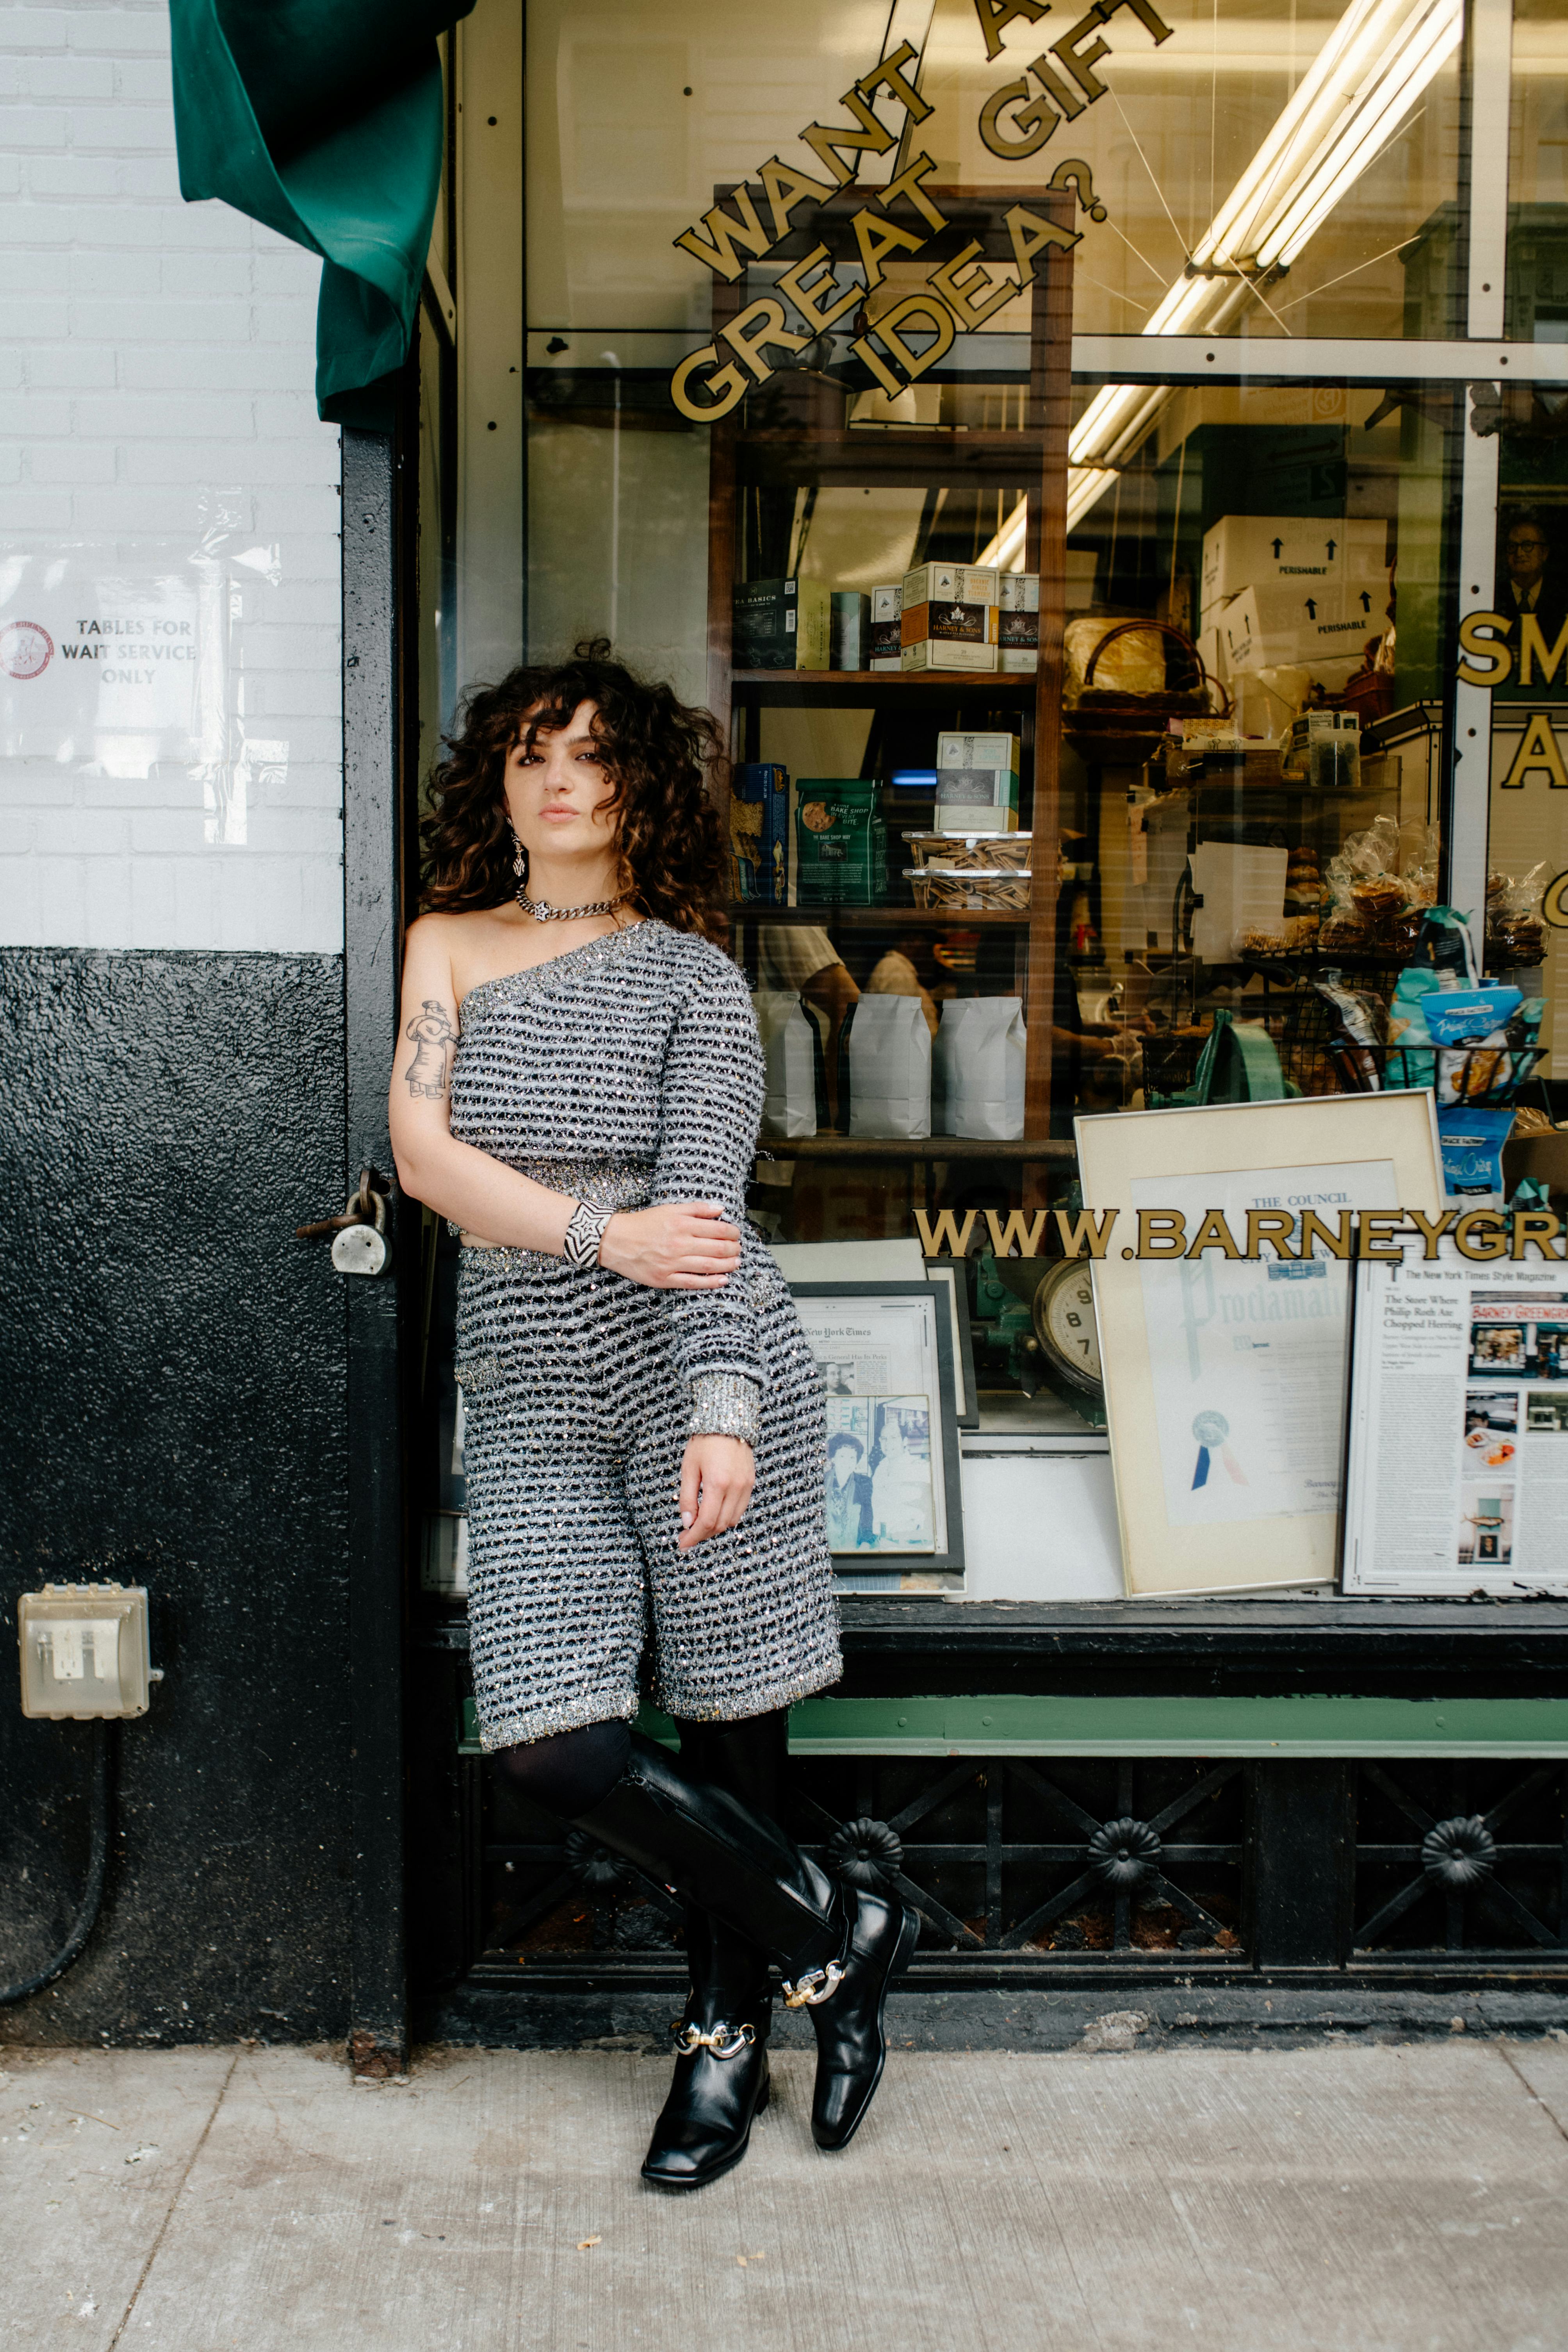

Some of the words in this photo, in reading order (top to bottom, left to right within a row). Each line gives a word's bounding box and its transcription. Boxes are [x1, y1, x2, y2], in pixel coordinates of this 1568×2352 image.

[673, 39, 936, 285] WANT
[974, 0, 1051, 62] A
[668, 150, 953, 426] GREAT
[978, 0, 1174, 161] GIFT
[846, 158, 1108, 403] IDEA?
[1279, 566, 1327, 575] PERISHABLE
[77, 620, 145, 634] TABLES
[153, 620, 192, 635] FOR
[1318, 620, 1366, 634] PERISHABLE
[62, 645, 110, 659] WAIT
[118, 645, 196, 660] SERVICE
[102, 669, 156, 684] ONLY
[831, 806, 848, 814] BAKE
[1252, 1197, 1281, 1208] THE
[1287, 1192, 1352, 1206] COUNCIL
[911, 1207, 1568, 1262] WWW.BARNEYGR
[1406, 1270, 1420, 1279] The
[1423, 1270, 1441, 1279] New
[1444, 1270, 1462, 1279] York
[1465, 1271, 1490, 1280] Times
[1492, 1271, 1513, 1282] Style
[1516, 1272, 1556, 1283] Magazine
[1077, 1290, 1092, 1304] 9
[1385, 1295, 1402, 1303] The
[1405, 1295, 1427, 1304] Store
[1429, 1295, 1458, 1304] Where
[1066, 1312, 1082, 1327] 8
[1472, 1305, 1512, 1319] BARNEY
[805, 1327, 822, 1336] New
[824, 1327, 844, 1338] York
[845, 1327, 871, 1336] Times
[1383, 1319, 1425, 1331] Chopped
[1427, 1320, 1463, 1331] Herring
[1077, 1338, 1090, 1354] 7
